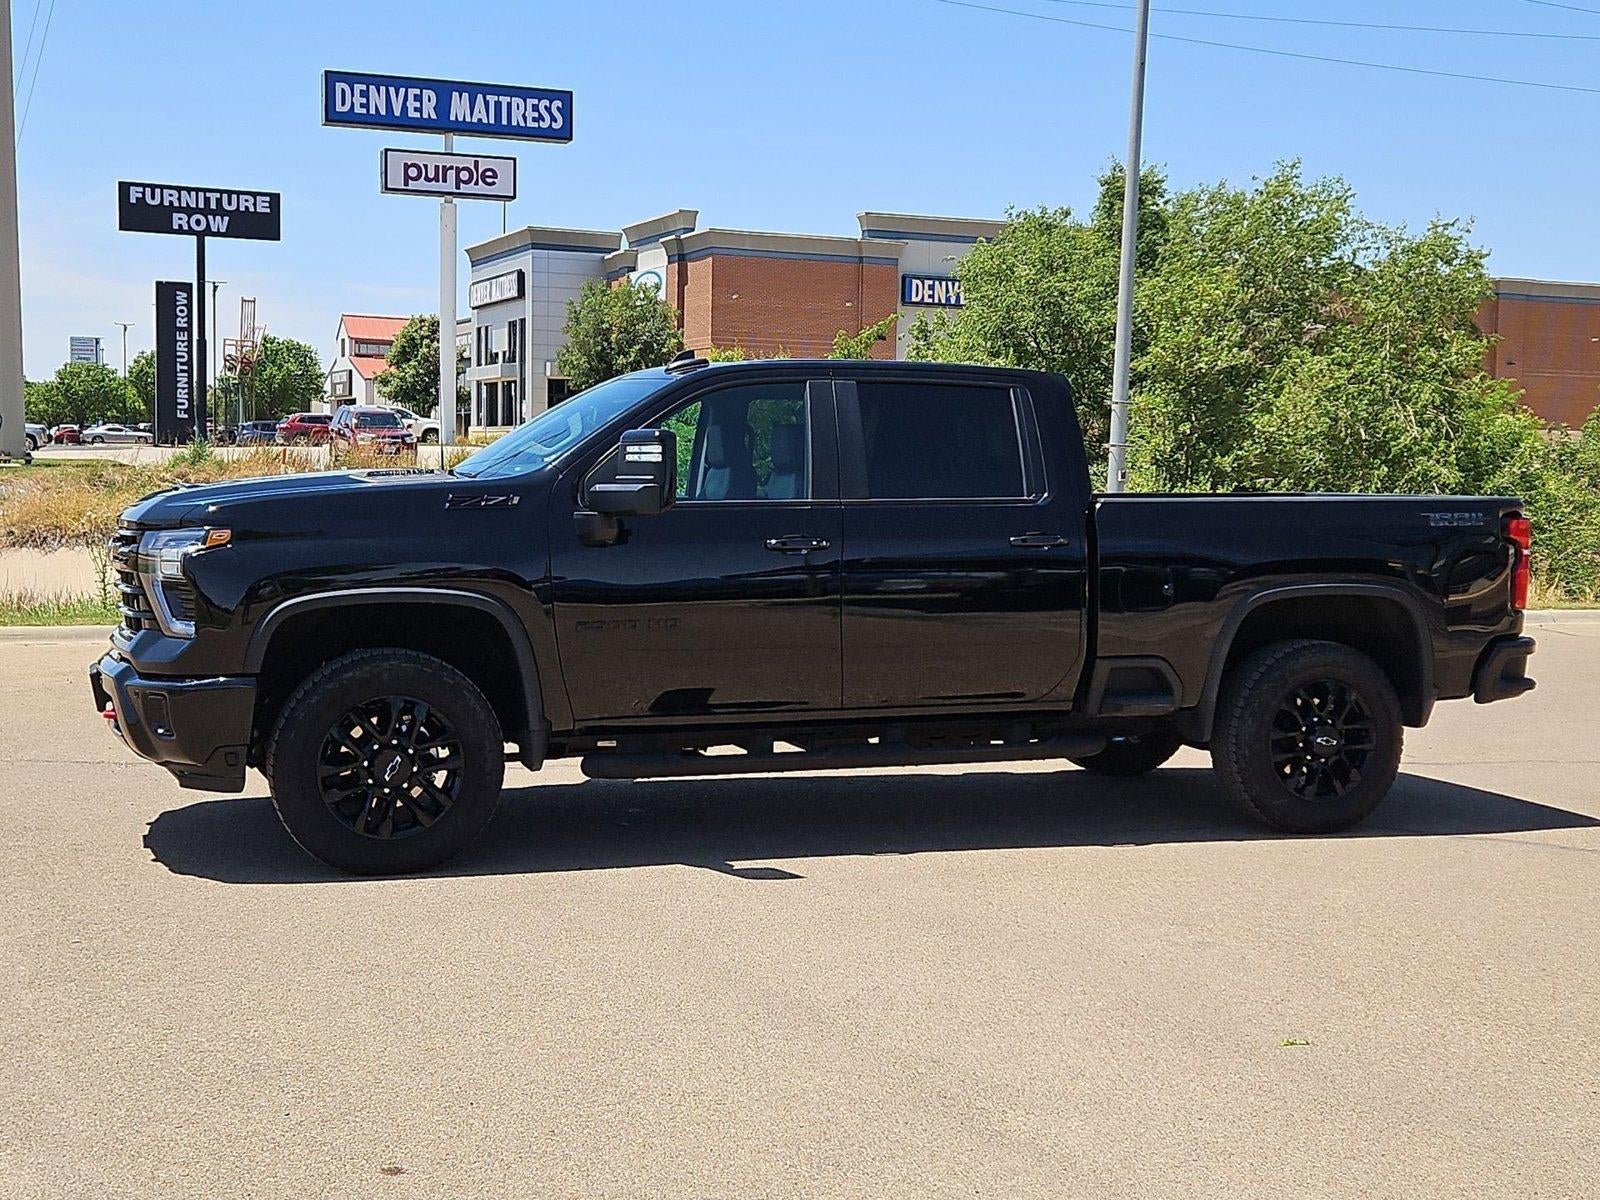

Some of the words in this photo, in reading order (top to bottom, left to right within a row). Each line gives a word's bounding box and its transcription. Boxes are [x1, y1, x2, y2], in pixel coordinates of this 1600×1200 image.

[335, 82, 437, 119] DENVER
[450, 91, 563, 130] MATTRESS
[403, 160, 499, 190] purple
[129, 186, 271, 213] FURNITURE
[172, 212, 230, 233] ROW
[176, 290, 188, 328] ROW
[176, 330, 189, 419] FURNITURE
